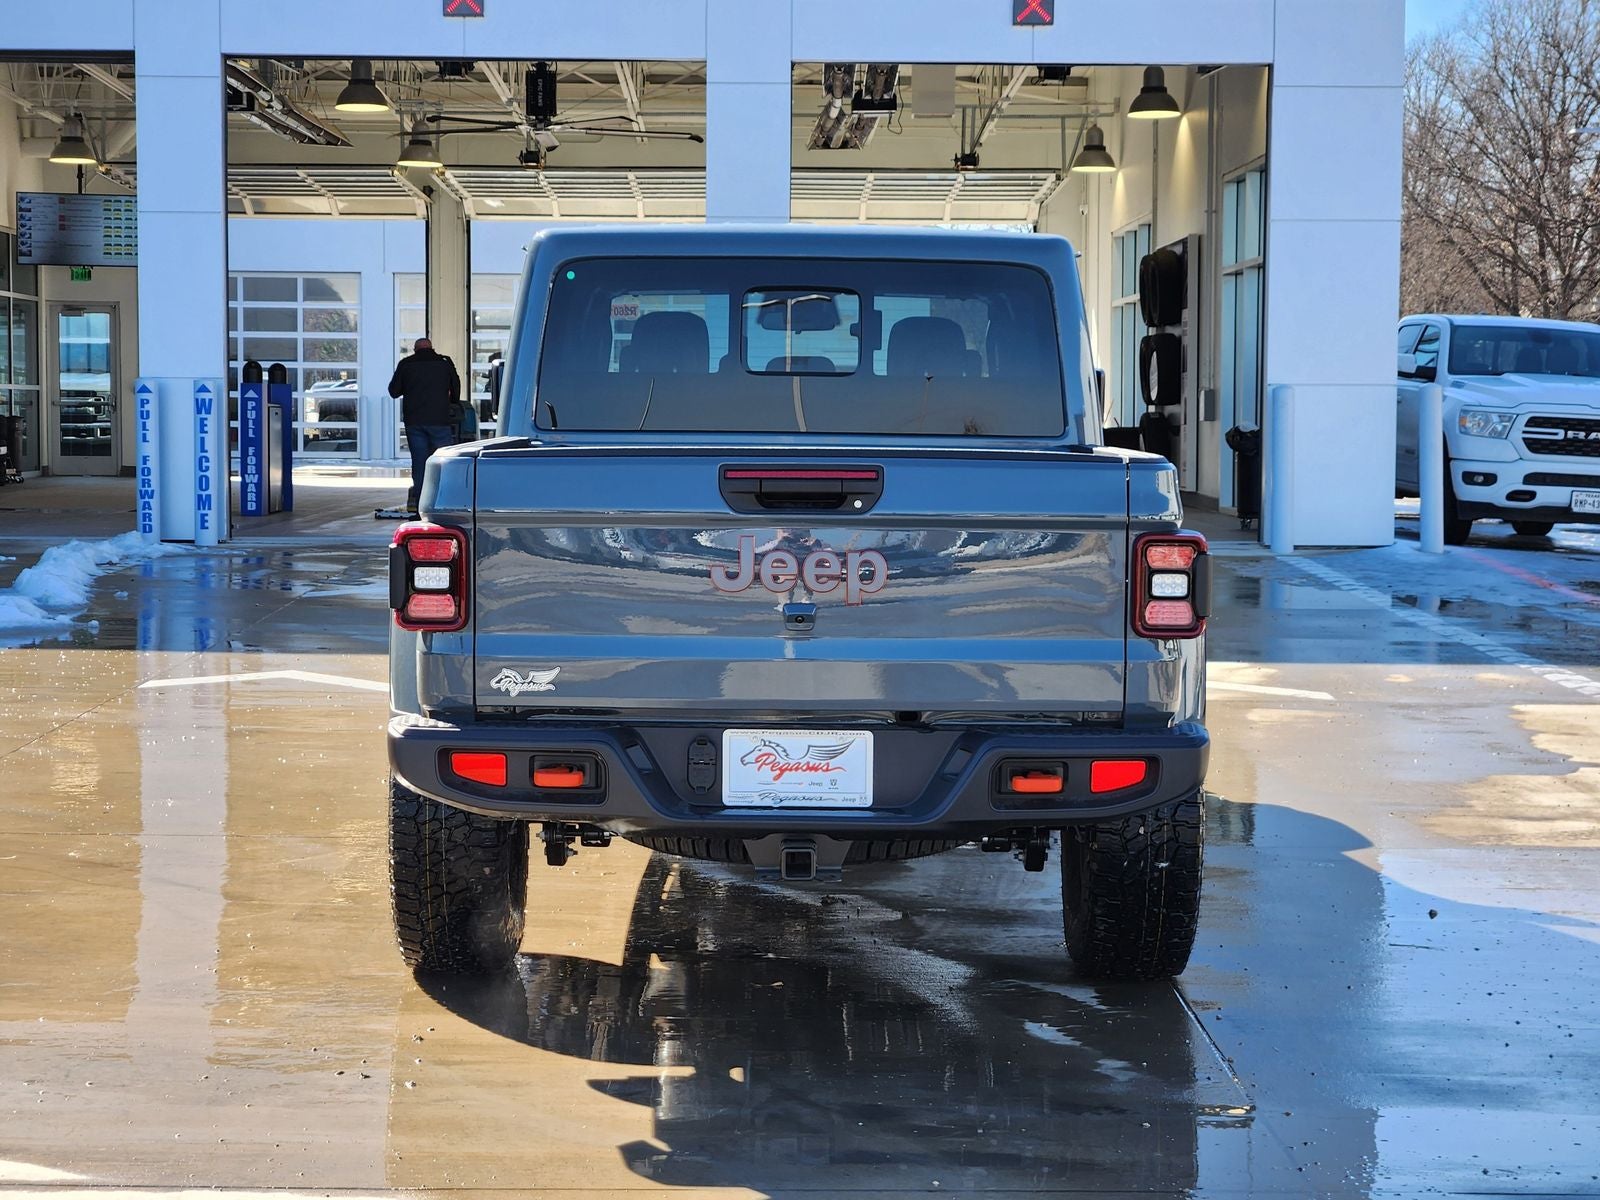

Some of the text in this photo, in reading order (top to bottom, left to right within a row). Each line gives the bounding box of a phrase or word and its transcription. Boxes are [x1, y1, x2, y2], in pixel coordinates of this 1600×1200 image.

[138, 398, 155, 534] PULL FORWARD
[195, 397, 213, 530] WELCOME
[244, 400, 259, 511] PULL FORWARD
[708, 535, 889, 606] Jeep
[500, 678, 556, 697] Pegasus
[755, 752, 847, 781] Pegasus
[758, 792, 837, 804] Pegasus
